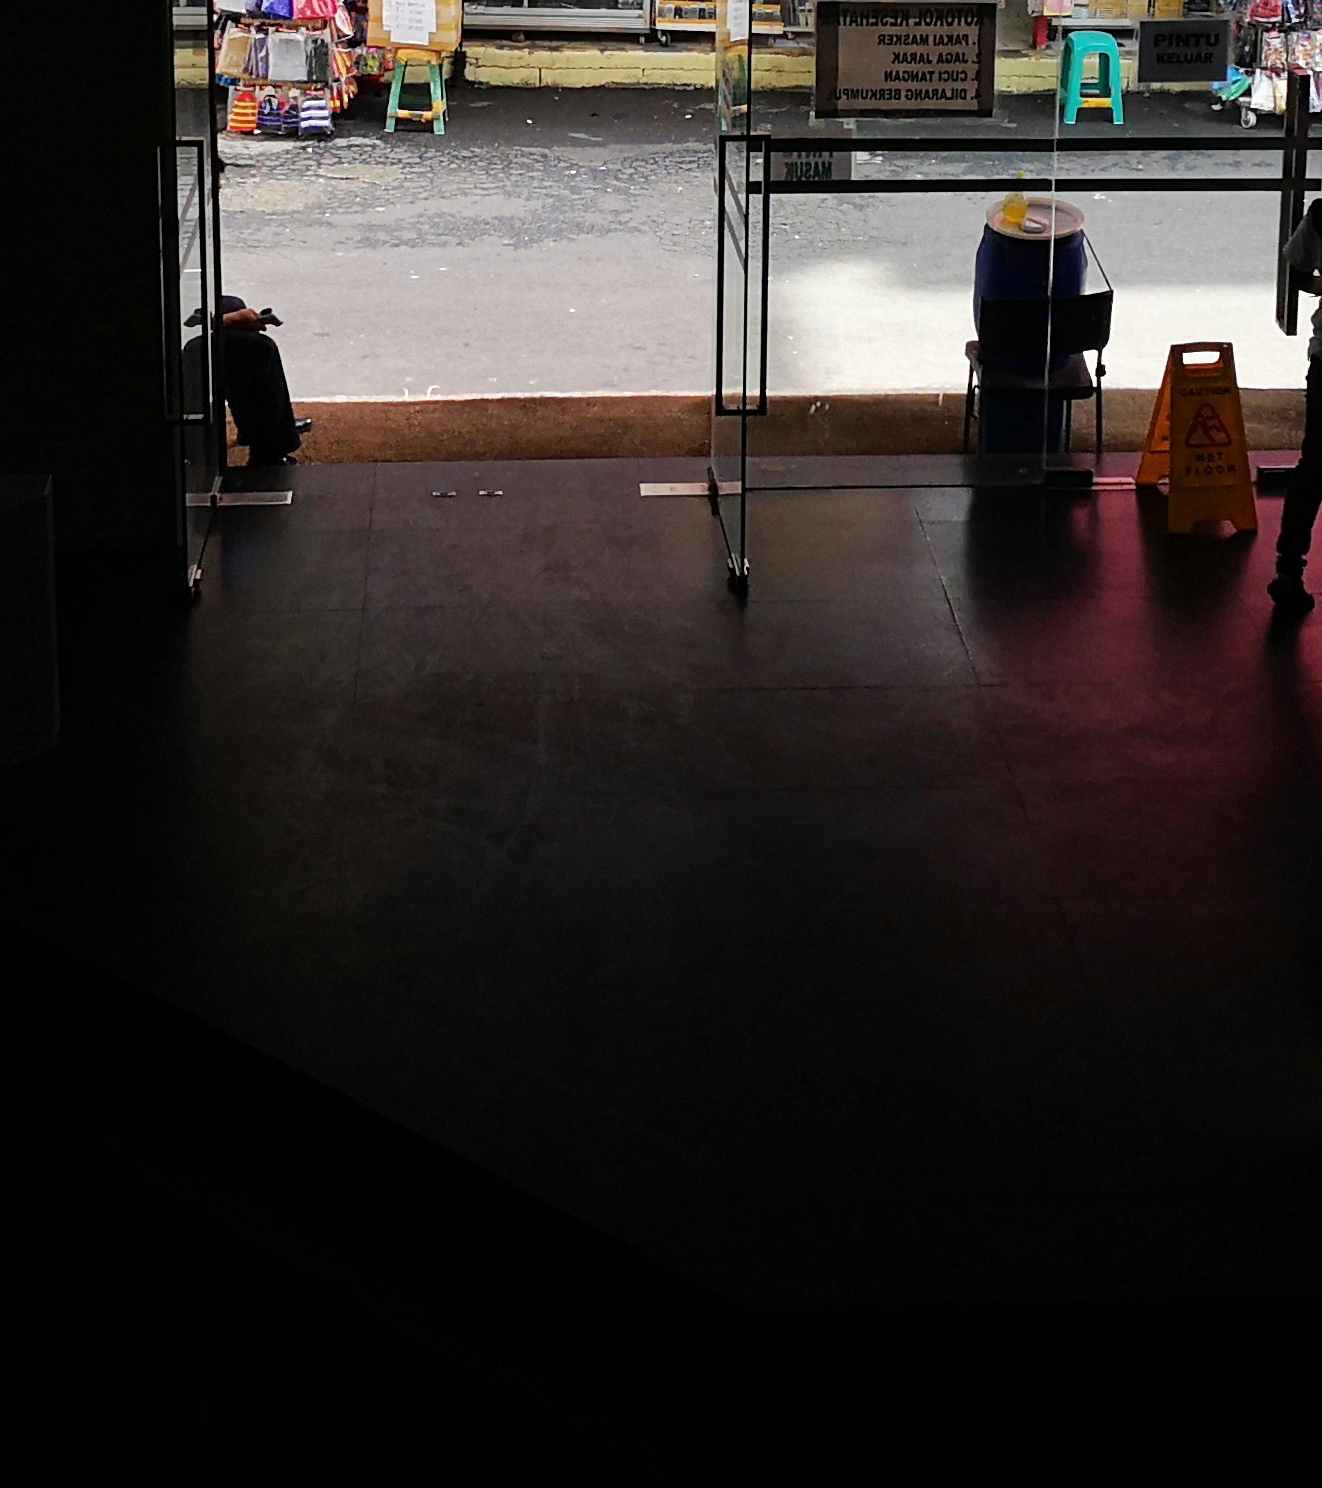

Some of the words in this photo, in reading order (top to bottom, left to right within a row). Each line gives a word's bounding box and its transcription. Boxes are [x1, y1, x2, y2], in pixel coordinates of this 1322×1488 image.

[1154, 33, 1219, 47] PINTU
[1156, 52, 1213, 64] KELUAR
[1179, 387, 1230, 397] CAUTION
[1194, 452, 1224, 463] WET
